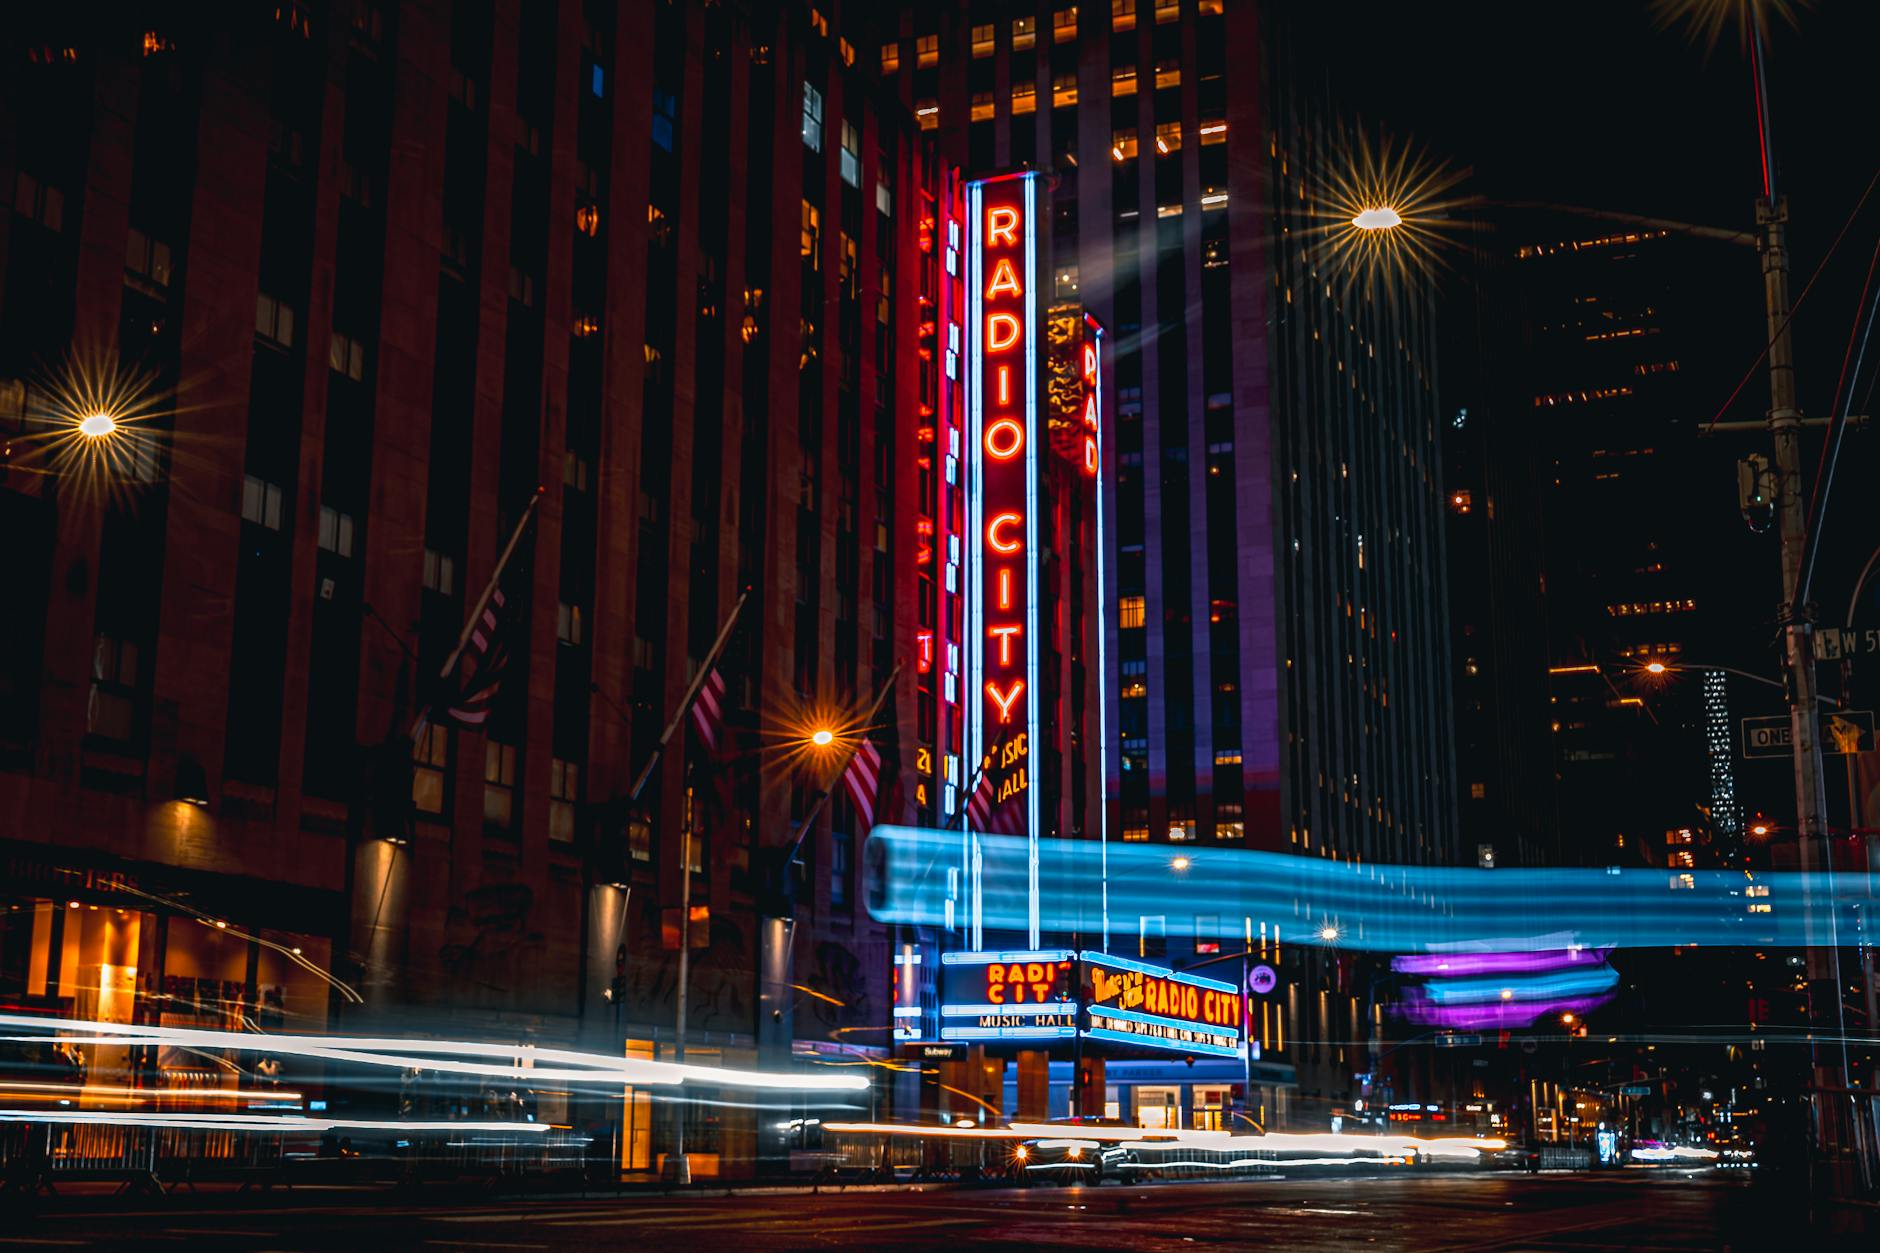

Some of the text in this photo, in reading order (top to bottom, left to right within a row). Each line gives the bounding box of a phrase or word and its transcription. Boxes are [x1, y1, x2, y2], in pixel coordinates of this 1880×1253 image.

[984, 205, 1024, 724] RADIO CITY
[1842, 632, 1856, 653] W
[1757, 730, 1791, 745] ONE
[988, 961, 1072, 983] RADI
[1144, 977, 1200, 1020] RADIO
[1203, 989, 1241, 1028] CITY
[980, 1013, 1076, 1028] MUSIC HALL
[924, 1046, 953, 1057] Subway
